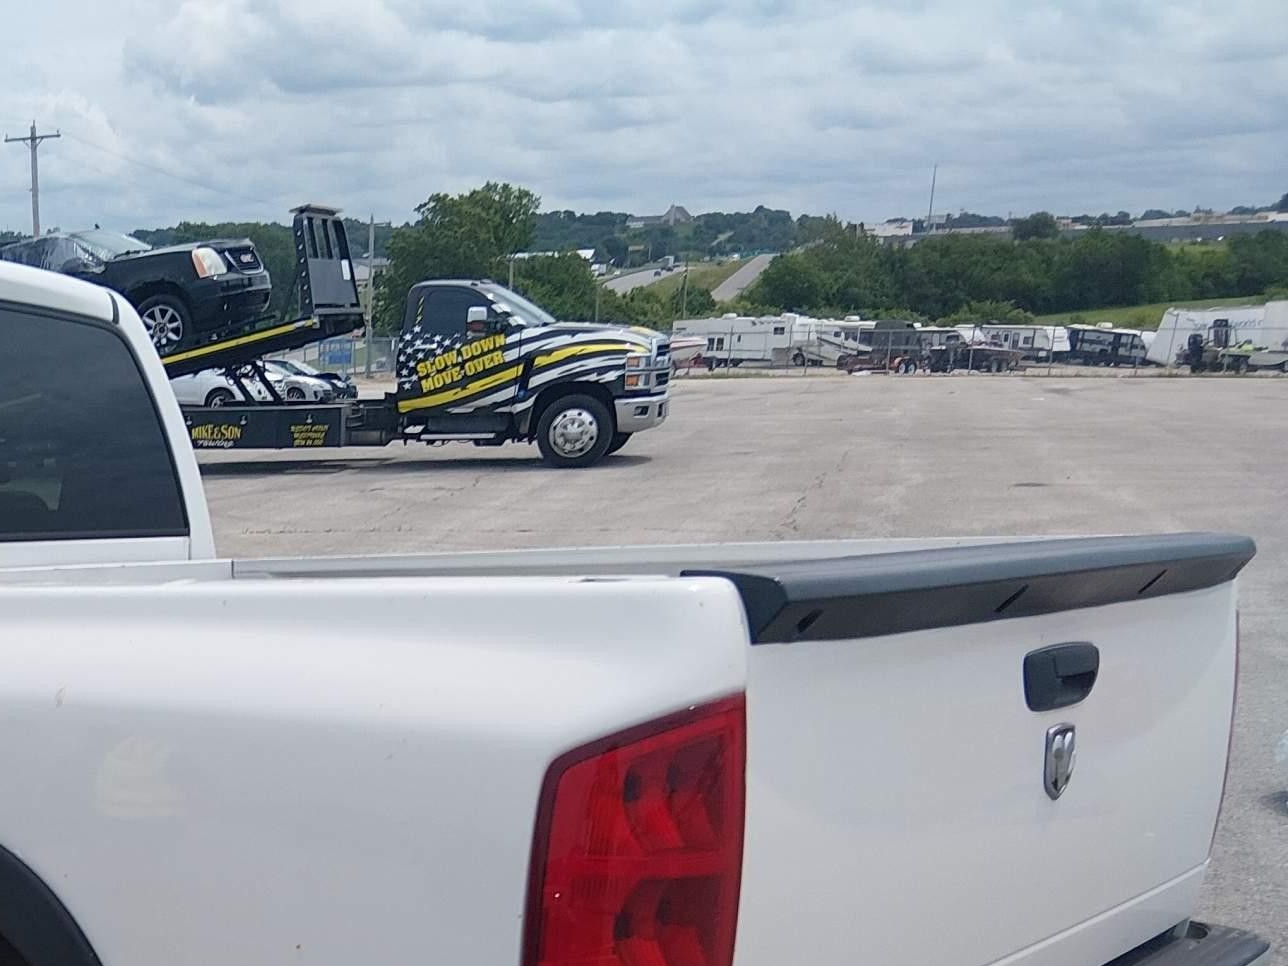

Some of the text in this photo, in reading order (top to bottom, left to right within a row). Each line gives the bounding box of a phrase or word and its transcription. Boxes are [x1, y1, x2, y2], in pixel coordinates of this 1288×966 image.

[417, 333, 505, 377] SLOW DOWN
[421, 350, 505, 393] MOVE OVER
